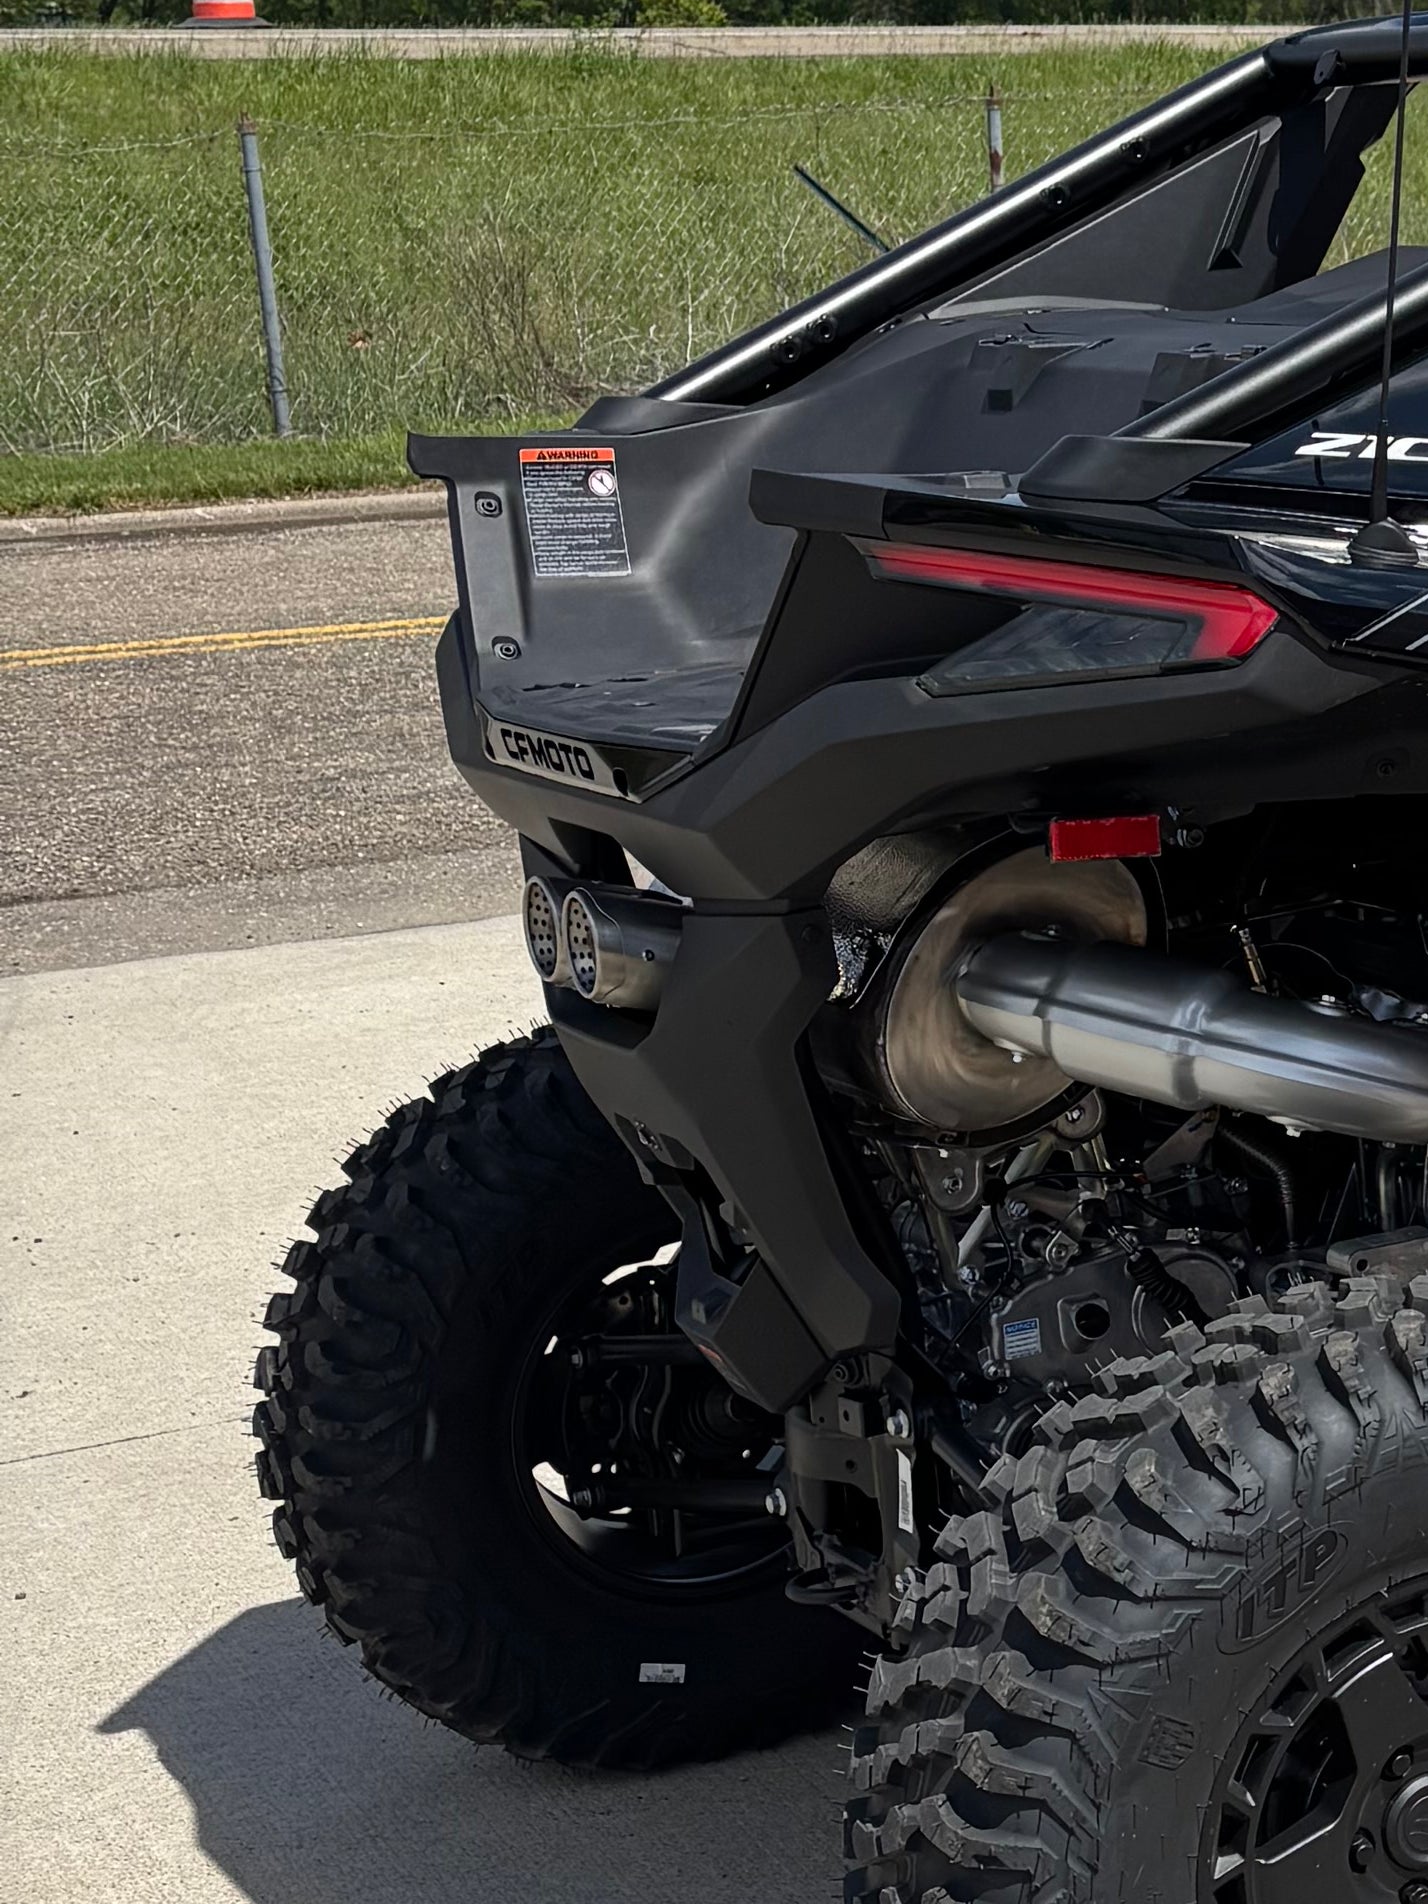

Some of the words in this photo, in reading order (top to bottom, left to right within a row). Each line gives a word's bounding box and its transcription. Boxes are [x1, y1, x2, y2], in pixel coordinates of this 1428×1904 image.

[547, 450, 599, 460] WARNING
[500, 727, 595, 781] CFMOTO
[1236, 1528, 1340, 1641] ITP
